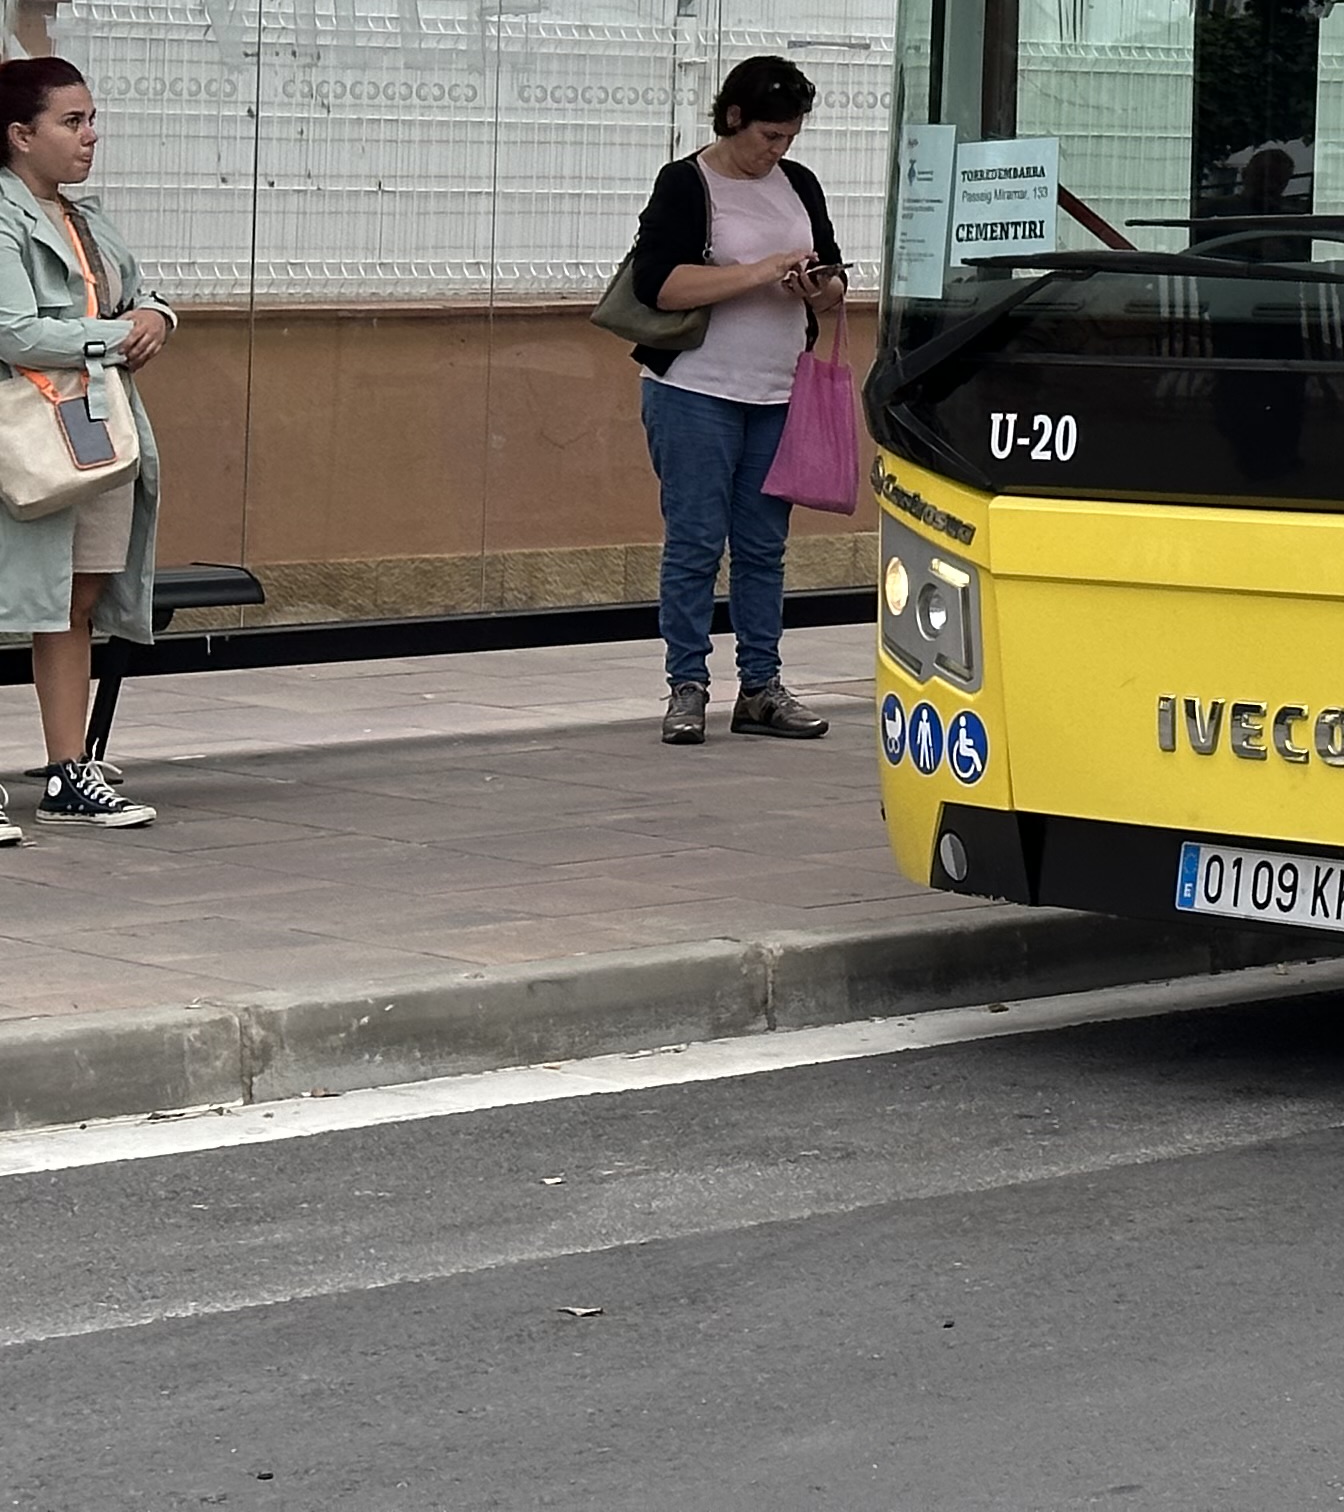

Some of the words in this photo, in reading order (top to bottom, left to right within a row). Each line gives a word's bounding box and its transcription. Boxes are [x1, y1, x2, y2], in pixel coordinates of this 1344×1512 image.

[961, 165, 1045, 182] TORREDEMBARRA
[955, 220, 1045, 242] CEMENTIRI
[990, 412, 1077, 461] U-20
[1204, 854, 1299, 912] 0109
